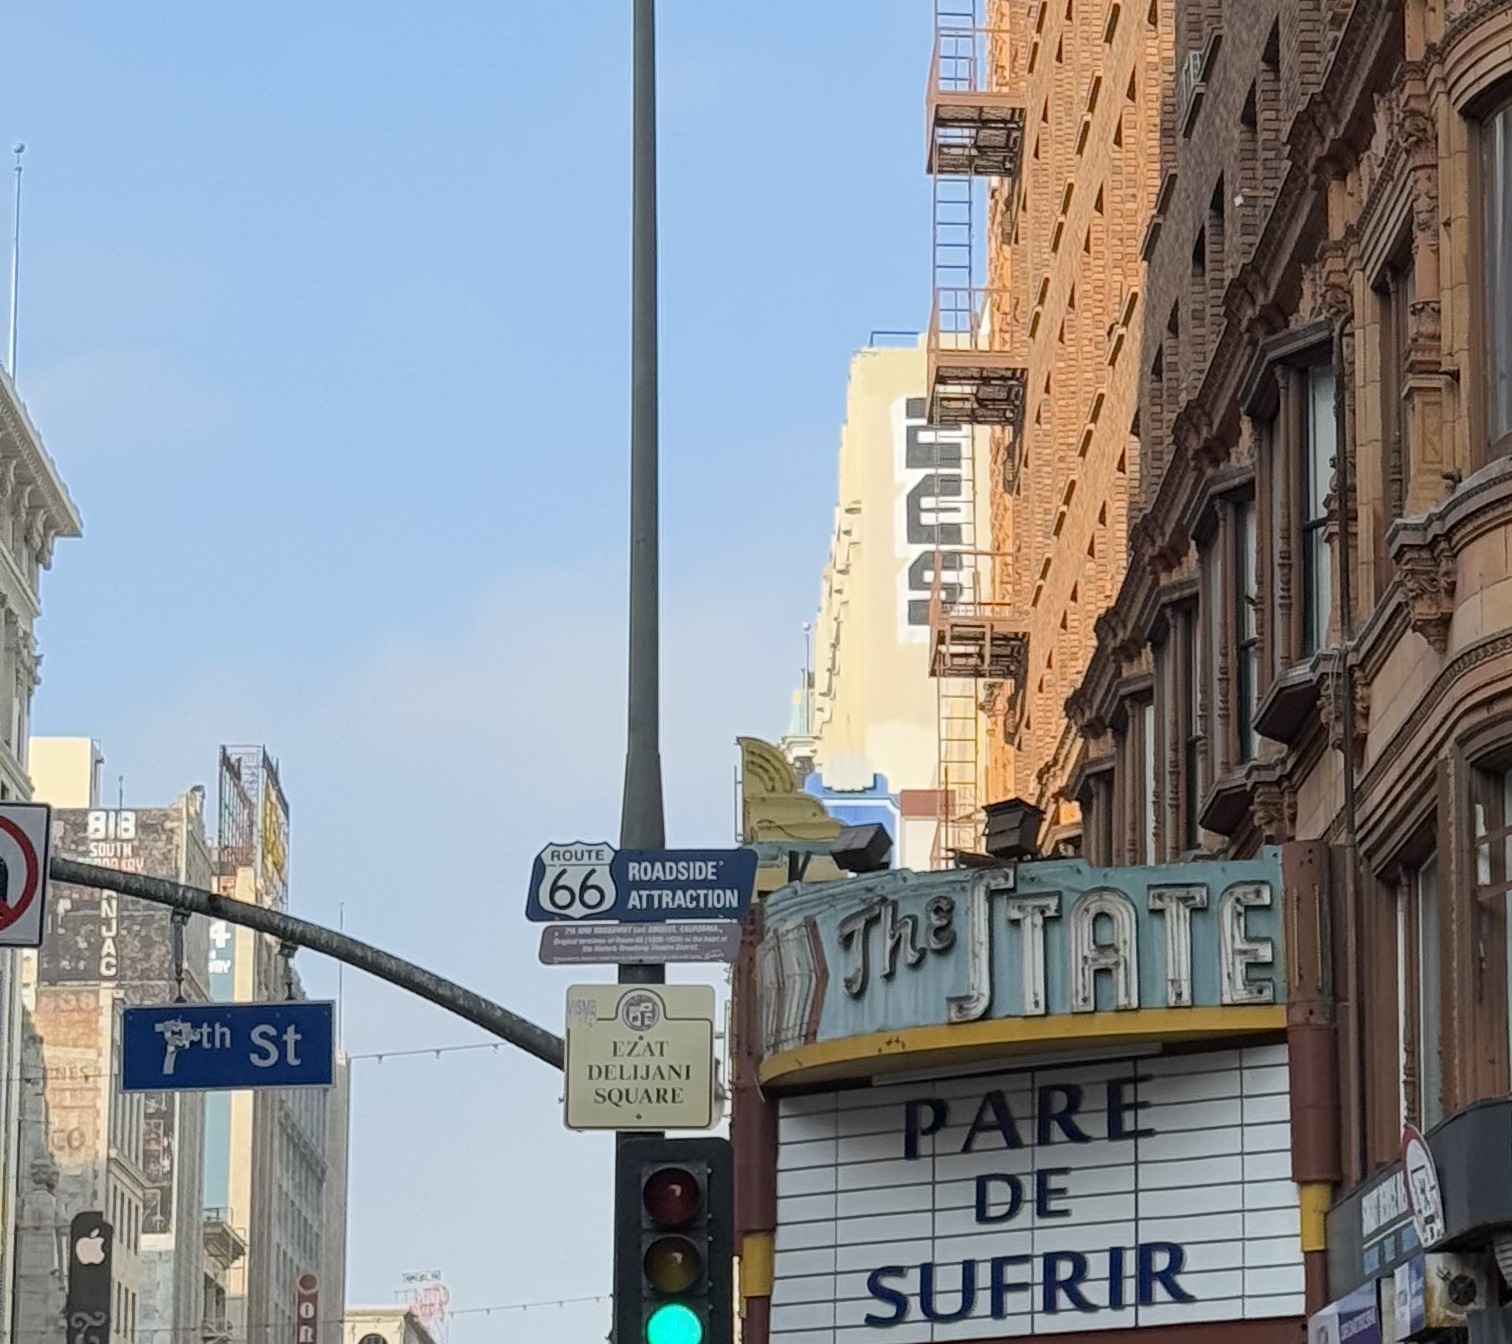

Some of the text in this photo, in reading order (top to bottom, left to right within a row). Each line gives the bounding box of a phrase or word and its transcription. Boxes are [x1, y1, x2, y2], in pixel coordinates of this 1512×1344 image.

[88, 811, 136, 840] 818
[90, 842, 132, 857] SOUTH
[550, 849, 605, 862] ROUTE
[628, 861, 718, 882] ROADSIDE
[549, 868, 605, 911] 66
[627, 889, 739, 910] ATTRACTION
[838, 894, 957, 999] The
[945, 865, 1276, 1025] STATE
[155, 1017, 302, 1075] 7th St
[612, 1040, 669, 1057] EZAT
[587, 1064, 691, 1081] DELIJANI
[593, 1087, 684, 1108] SQUARE
[904, 1074, 1156, 1161] PARE
[975, 1166, 1072, 1225] DE
[864, 1241, 1198, 1328] SUFRIR
